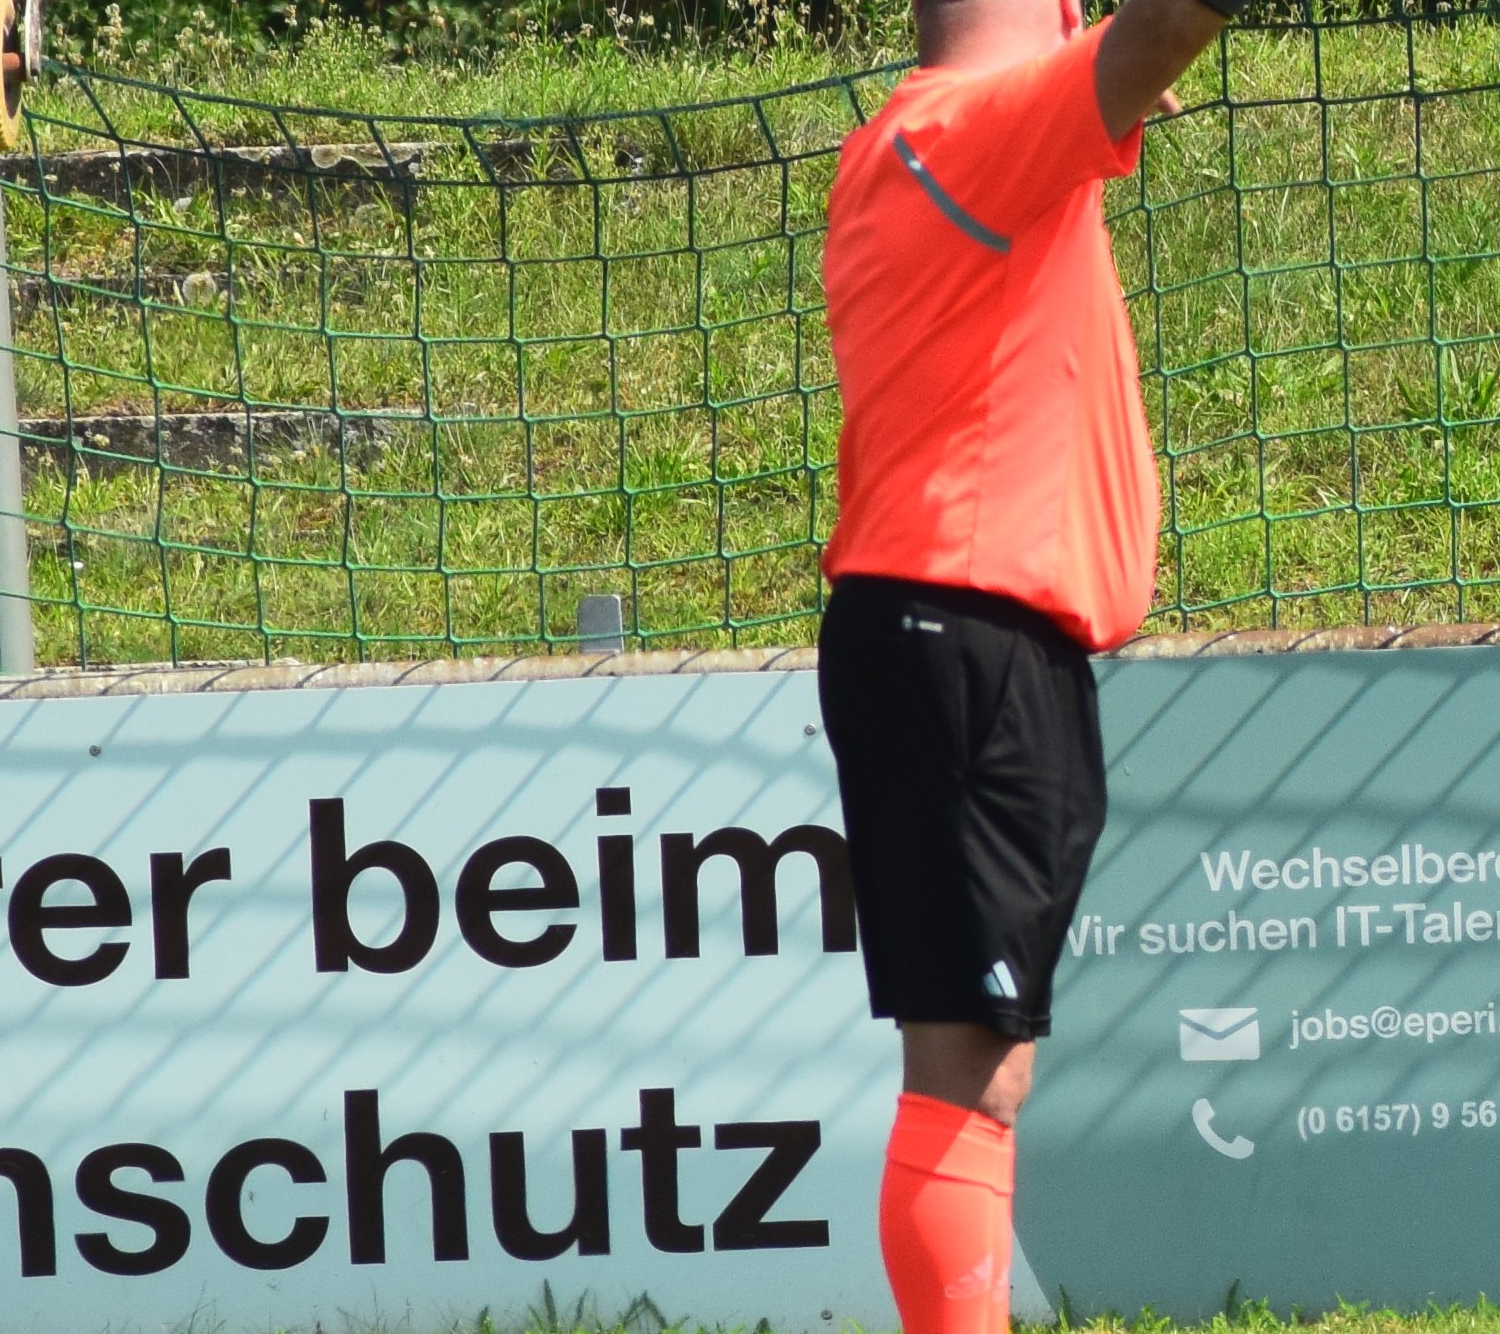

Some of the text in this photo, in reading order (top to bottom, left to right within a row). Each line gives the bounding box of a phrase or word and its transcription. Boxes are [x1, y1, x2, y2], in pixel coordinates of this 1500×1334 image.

[309, 787, 858, 974] beim
[1139, 910, 1317, 955] suchen
[1297, 1105, 1326, 1142] (0
[1335, 1102, 1422, 1137] 6157)
[1430, 1101, 1450, 1129] 9
[1461, 1100, 1498, 1128] 56
